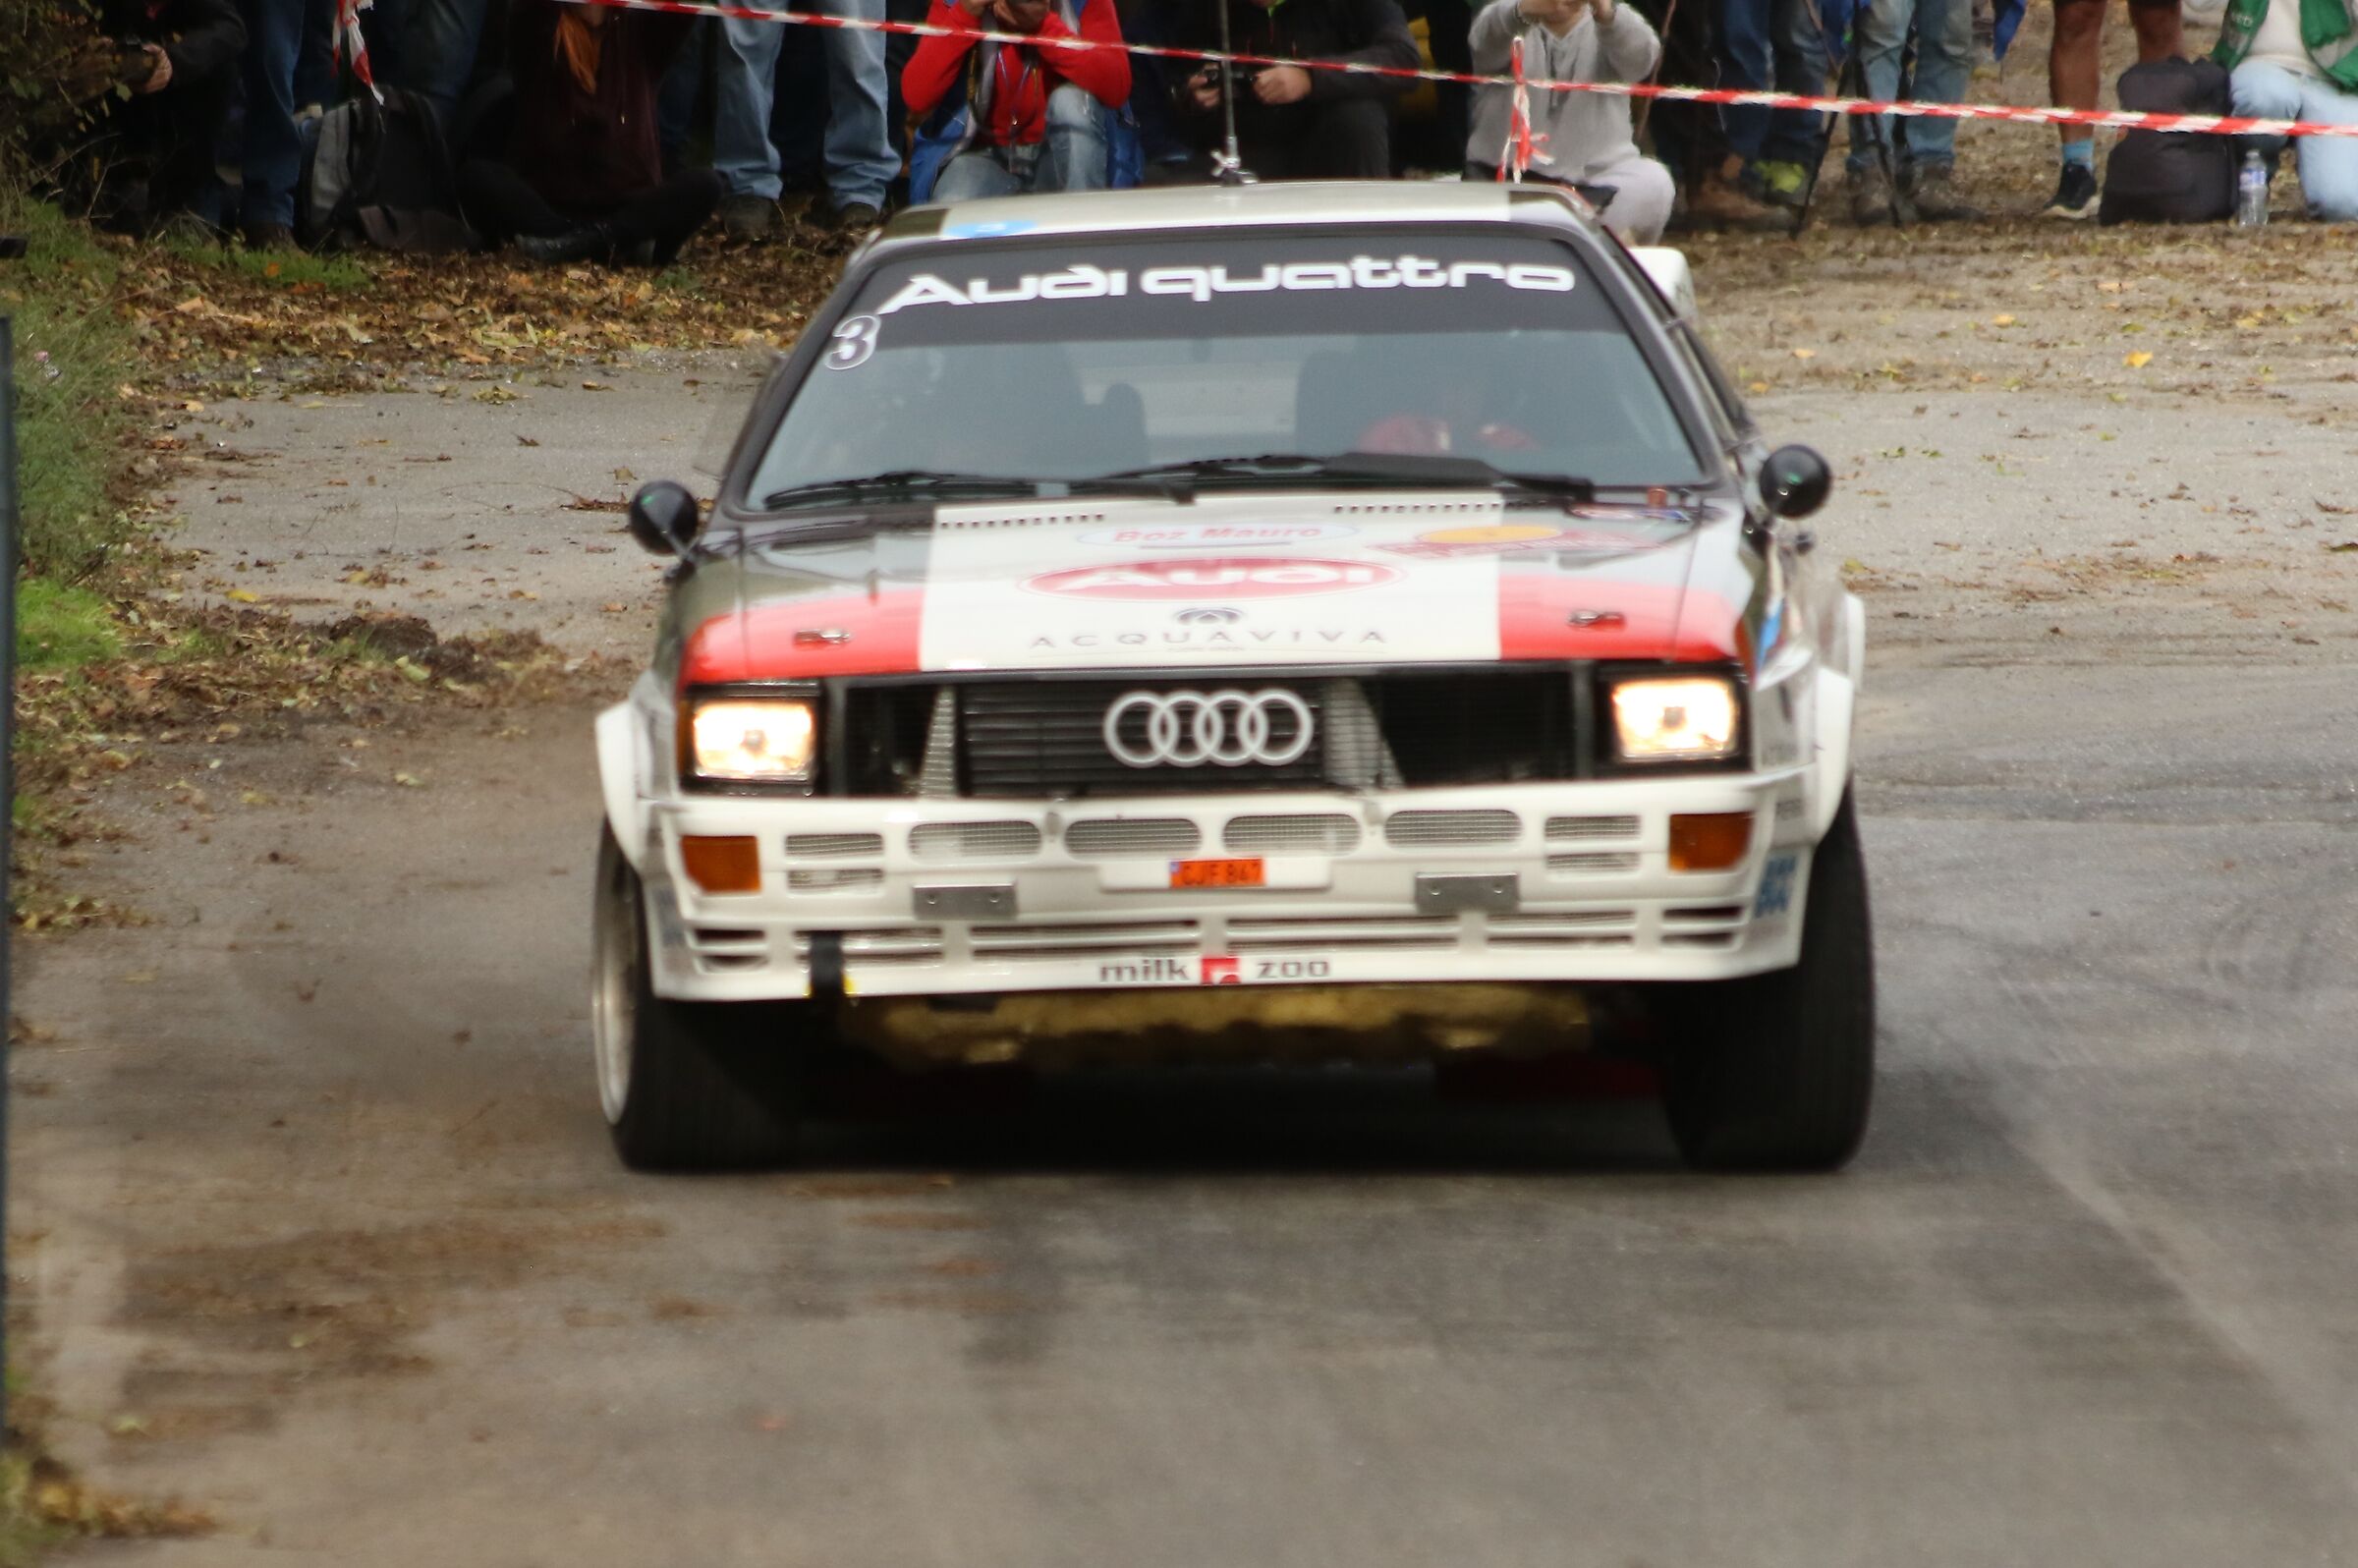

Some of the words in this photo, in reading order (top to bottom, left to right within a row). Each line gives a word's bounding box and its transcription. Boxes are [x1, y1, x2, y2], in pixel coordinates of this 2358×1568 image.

[1141, 254, 1574, 302] quattro
[824, 314, 881, 370] 3
[1200, 526, 1321, 540] Mauro
[1029, 629, 1388, 649] ACQUAVIVA
[1100, 959, 1189, 982] milk
[1257, 961, 1330, 980] zoo
